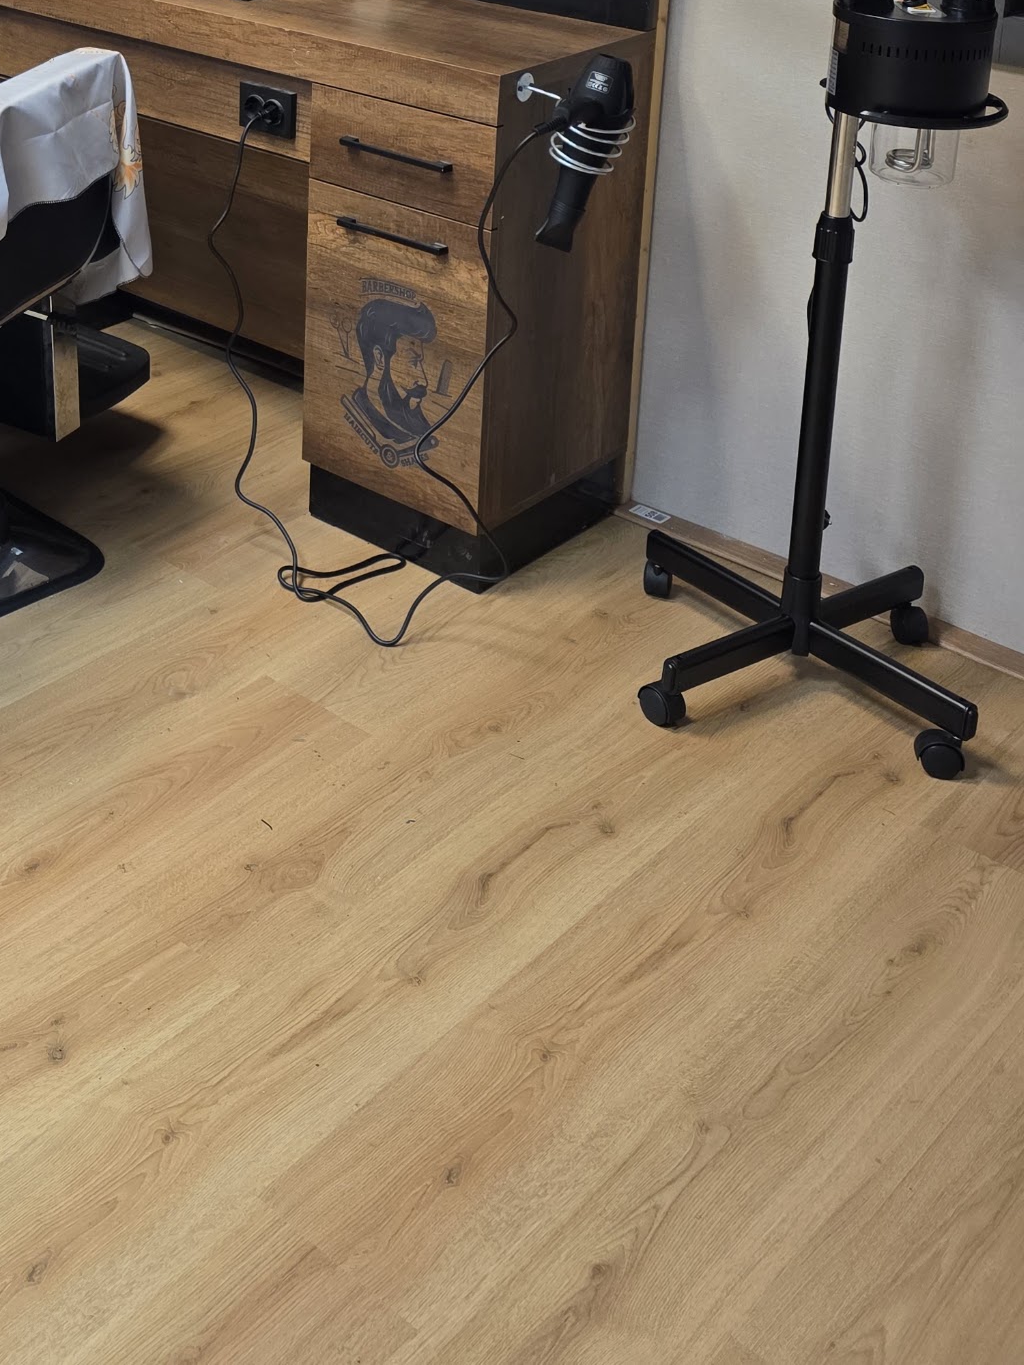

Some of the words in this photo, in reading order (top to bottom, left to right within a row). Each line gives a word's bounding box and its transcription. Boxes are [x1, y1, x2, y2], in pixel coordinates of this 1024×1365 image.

[361, 280, 417, 301] BARBERSHOP
[344, 413, 378, 454] HAIRCUTS
[400, 453, 430, 467] SHAES
